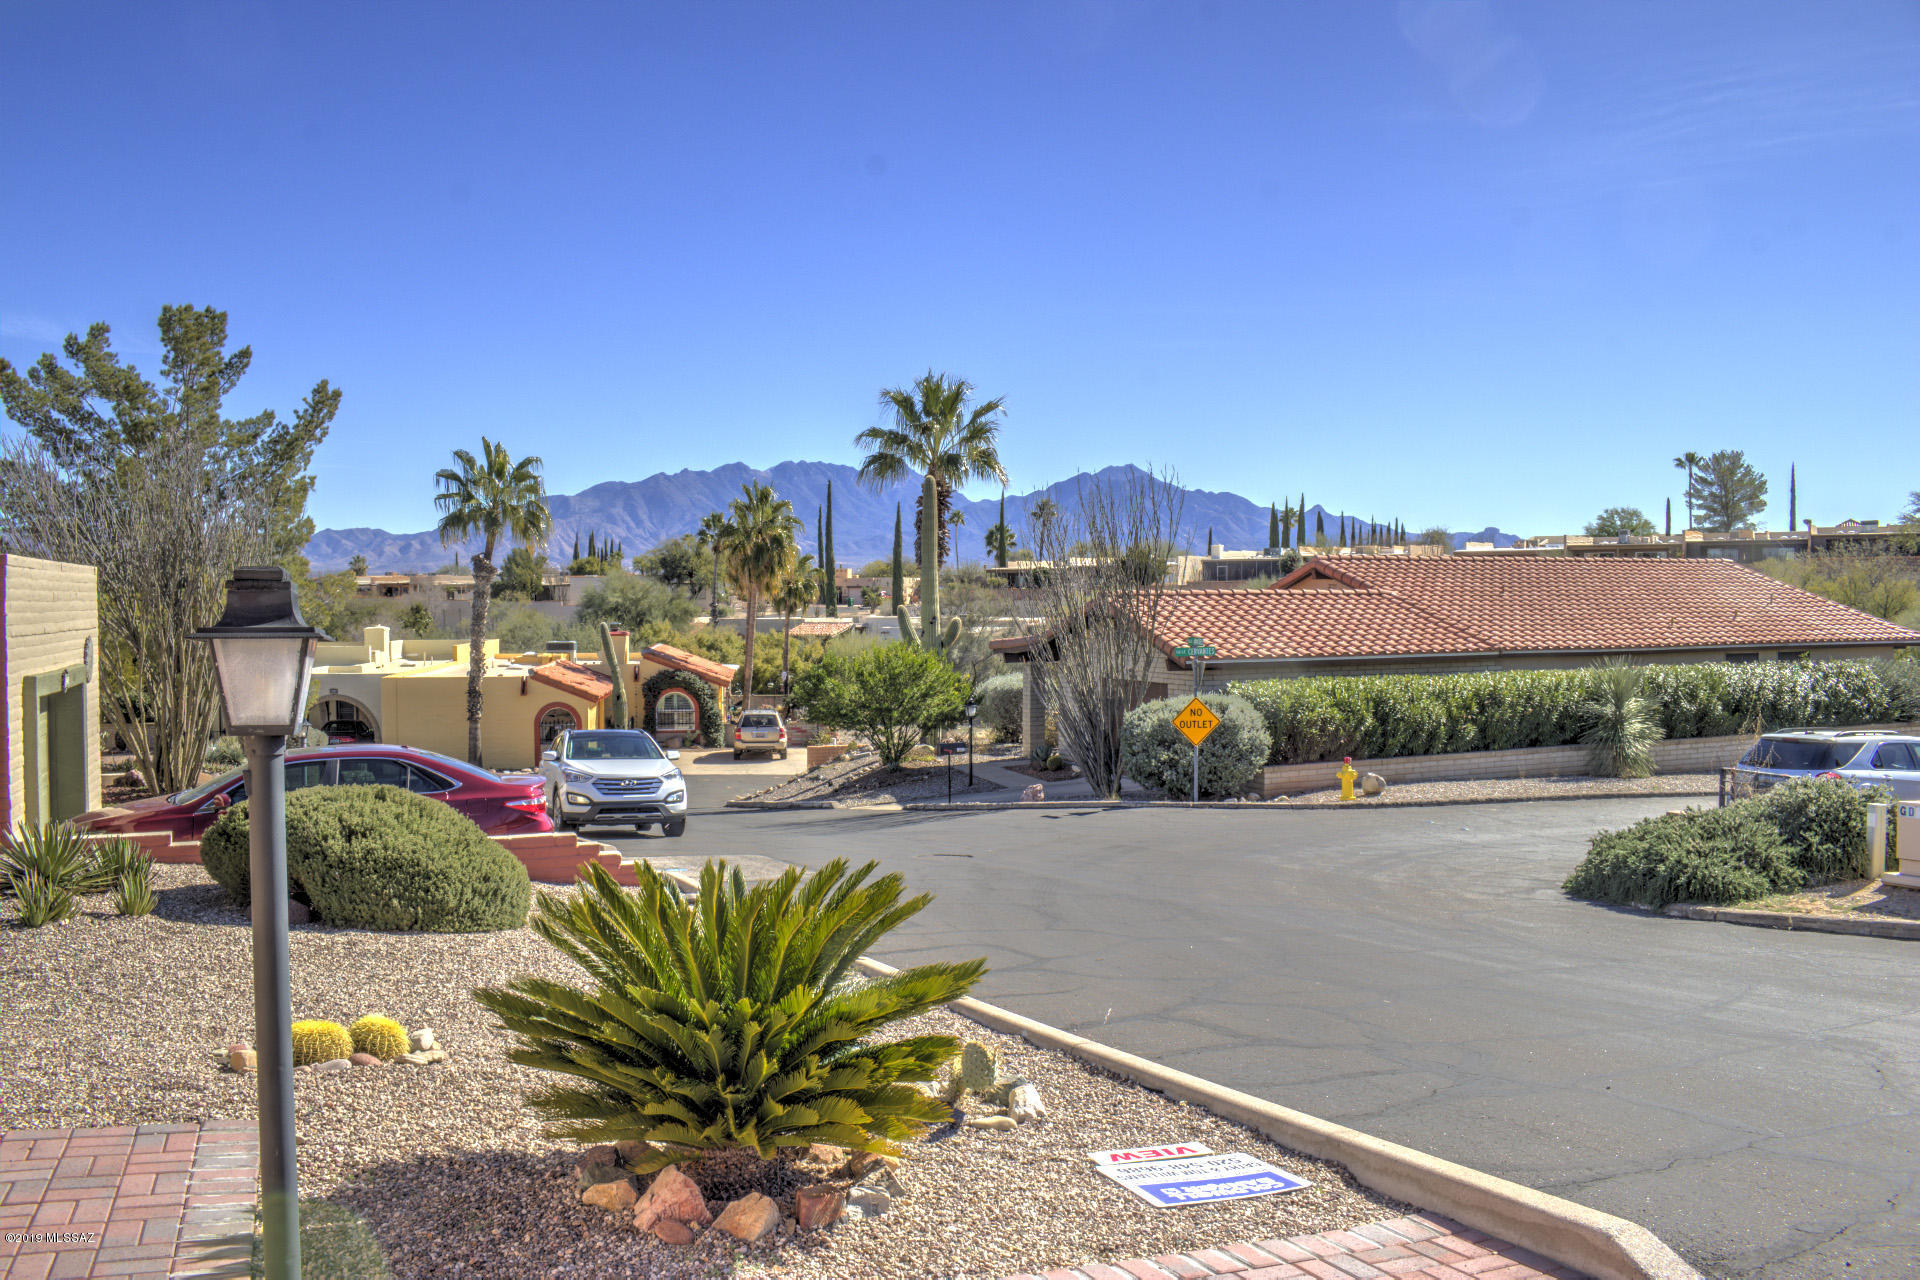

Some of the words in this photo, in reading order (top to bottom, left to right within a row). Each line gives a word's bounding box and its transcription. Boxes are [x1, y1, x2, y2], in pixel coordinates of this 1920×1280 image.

[1187, 647, 1215, 656] CERVANTES
[1190, 708, 1203, 717] NO
[1179, 720, 1213, 729] OUTLET
[1110, 1146, 1198, 1162] VIEW
